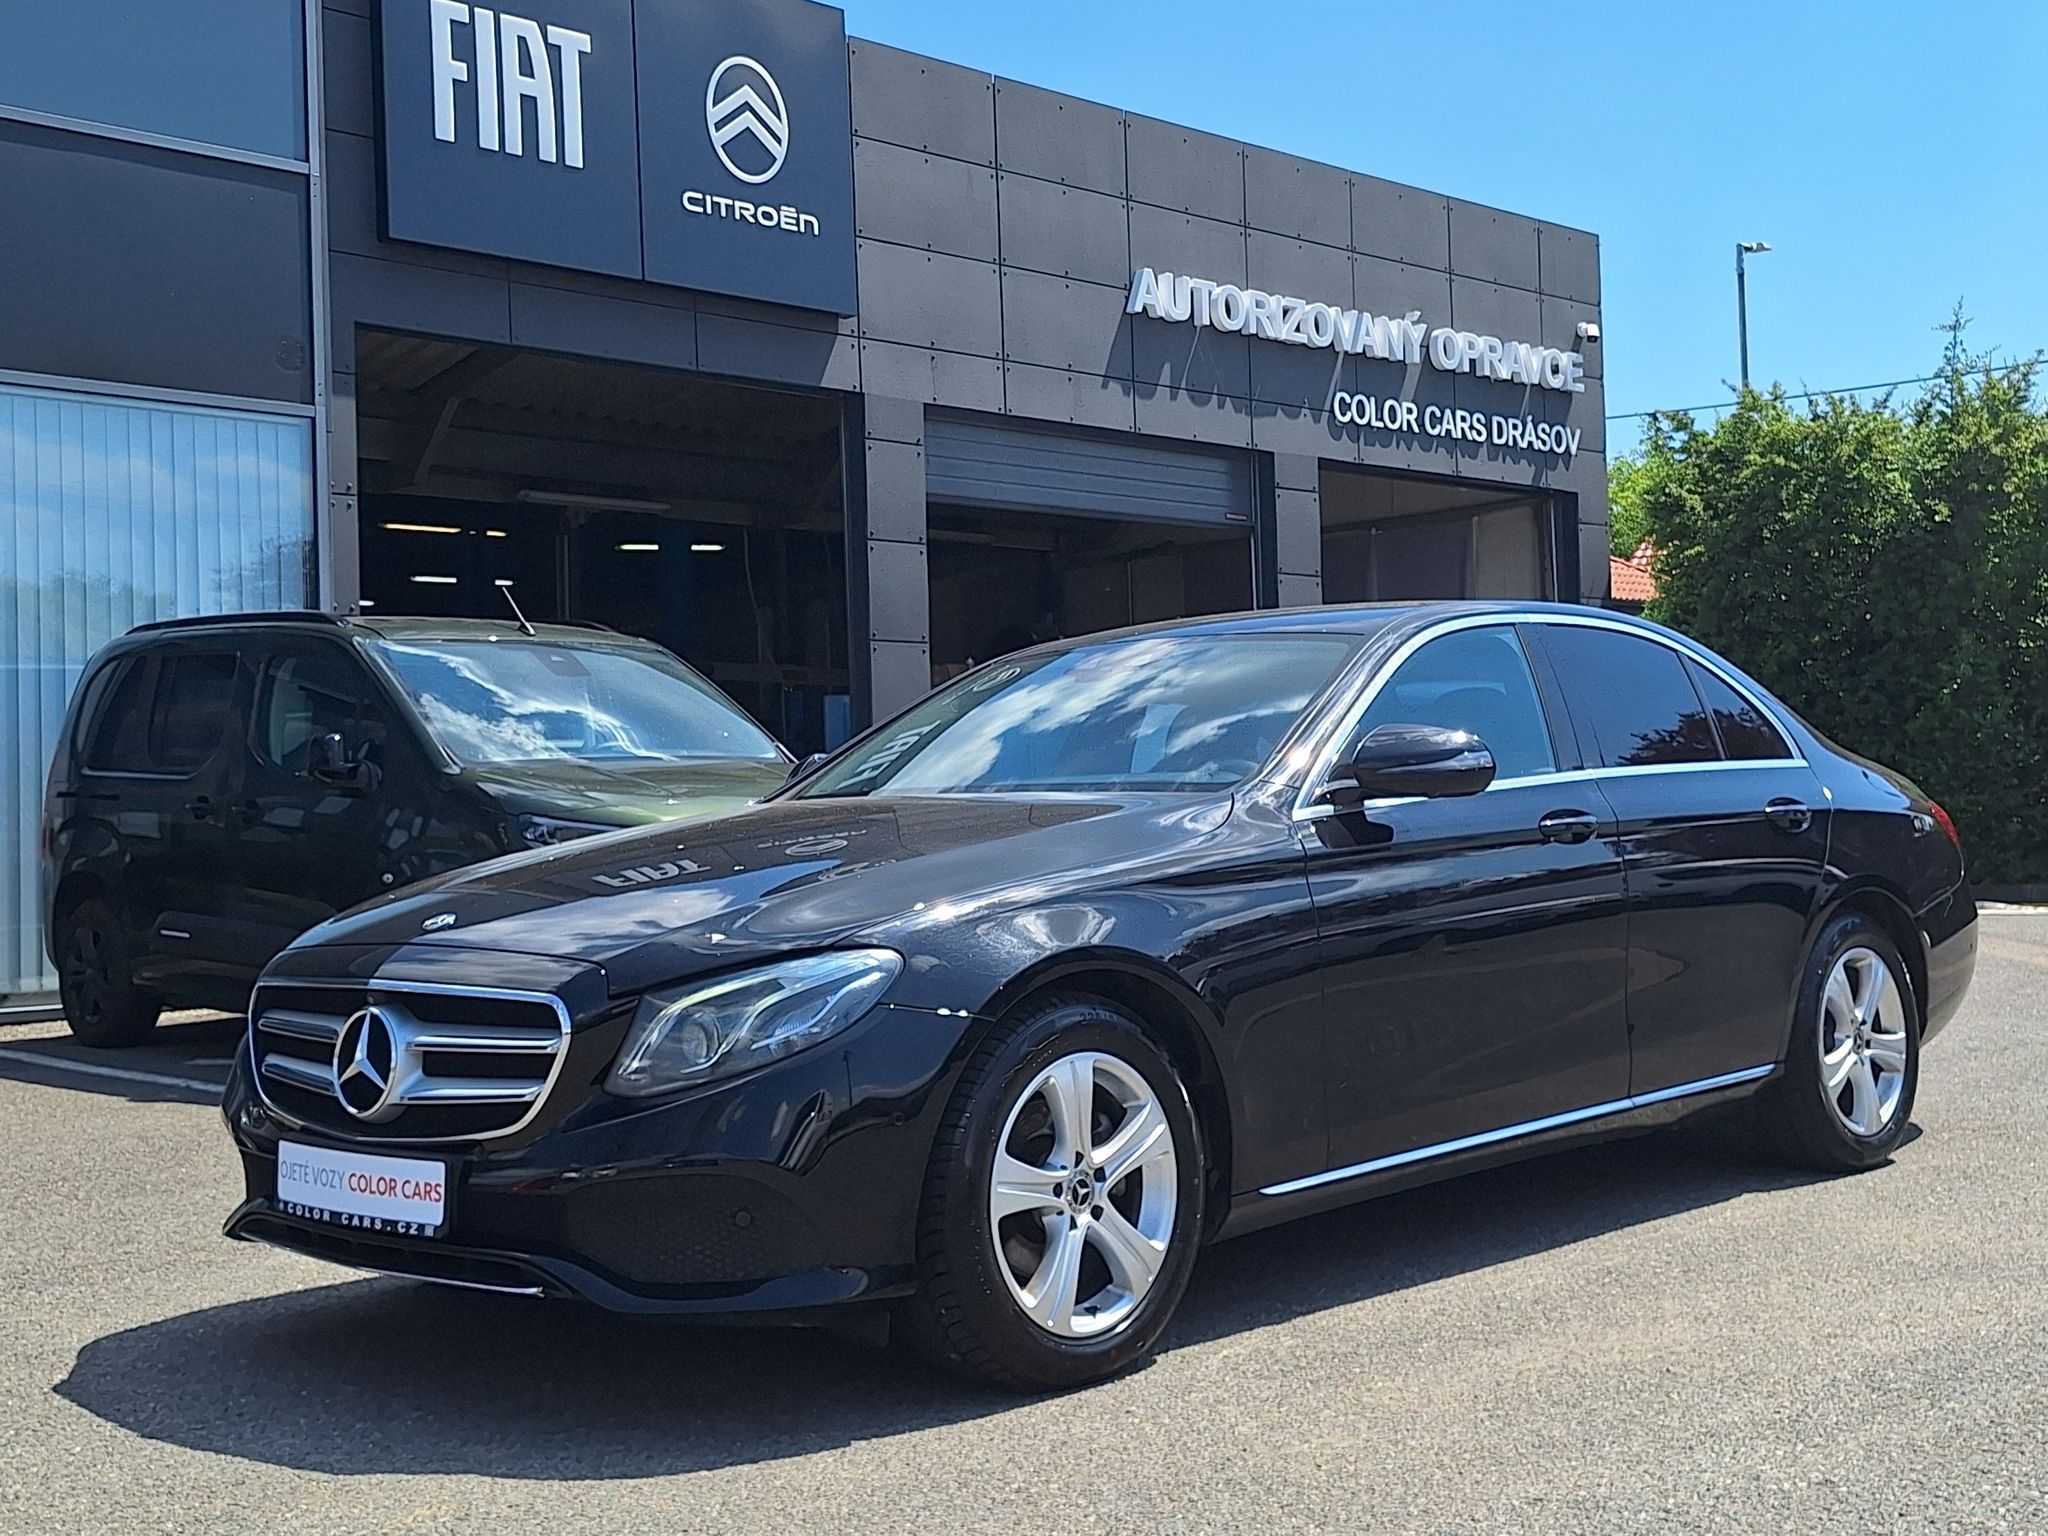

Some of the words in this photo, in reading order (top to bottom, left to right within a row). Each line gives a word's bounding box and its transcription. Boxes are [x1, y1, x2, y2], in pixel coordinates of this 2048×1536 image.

[430, 0, 591, 170] FIAT
[1126, 267, 1427, 364] AUTORIZOVANÝ
[1429, 328, 1586, 393] OPRAVCE
[1333, 391, 1419, 434] COLOR
[1424, 405, 1487, 442] CARS
[1492, 414, 1581, 456] DRÁSOV
[280, 1160, 310, 1184] OJETÉ
[312, 1167, 345, 1190] VOZY
[348, 1172, 398, 1197] COLOR
[401, 1179, 442, 1203] CARS
[287, 1204, 331, 1222] COLOR
